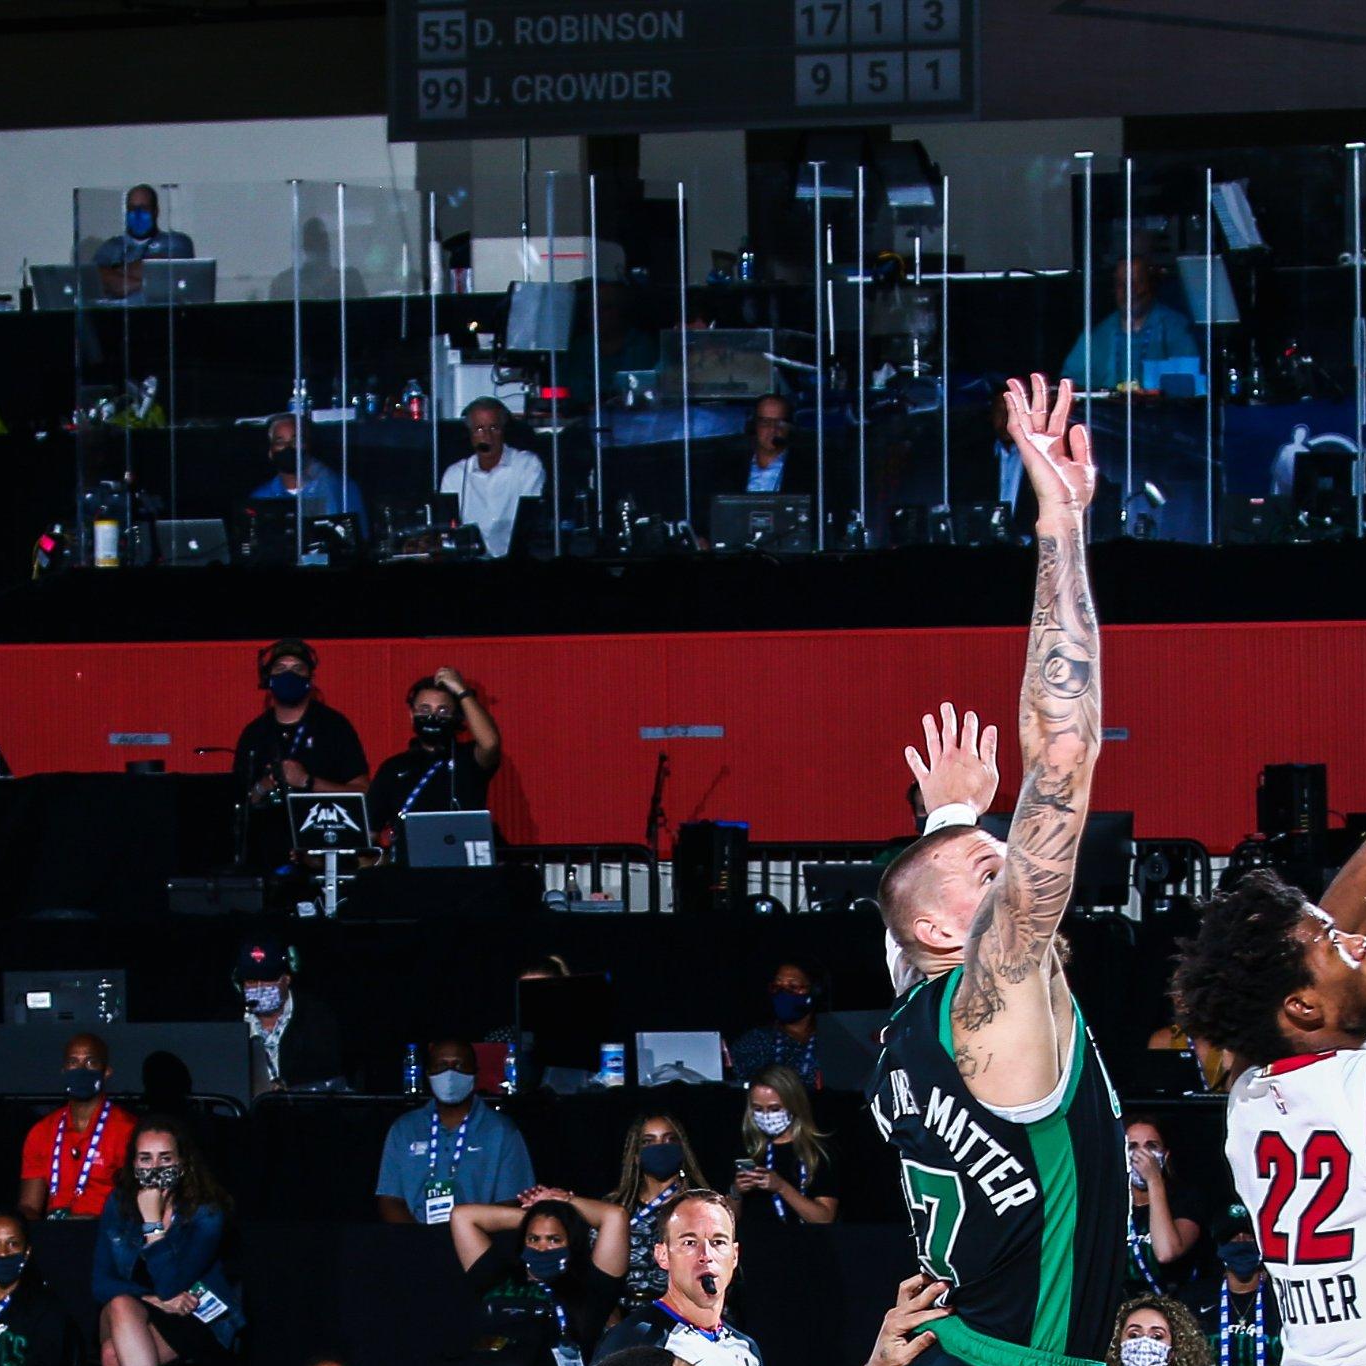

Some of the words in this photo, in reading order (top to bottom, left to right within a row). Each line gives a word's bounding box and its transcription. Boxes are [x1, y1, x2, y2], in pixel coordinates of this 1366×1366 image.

[421, 18, 464, 52] 55
[473, 19, 503, 46] D.
[514, 11, 684, 45] ROBINSON
[800, 3, 841, 37] 17
[868, 3, 883, 34] 1
[923, 0, 944, 31] 3
[422, 75, 464, 109] 99
[474, 77, 500, 105] J.
[511, 70, 672, 104] CROWDER
[809, 61, 831, 94] 9
[867, 58, 889, 92] 5
[923, 58, 941, 91] 1
[924, 1086, 1037, 1217] MATTER
[1254, 1130, 1355, 1266] 22
[900, 1150, 966, 1288] 7
